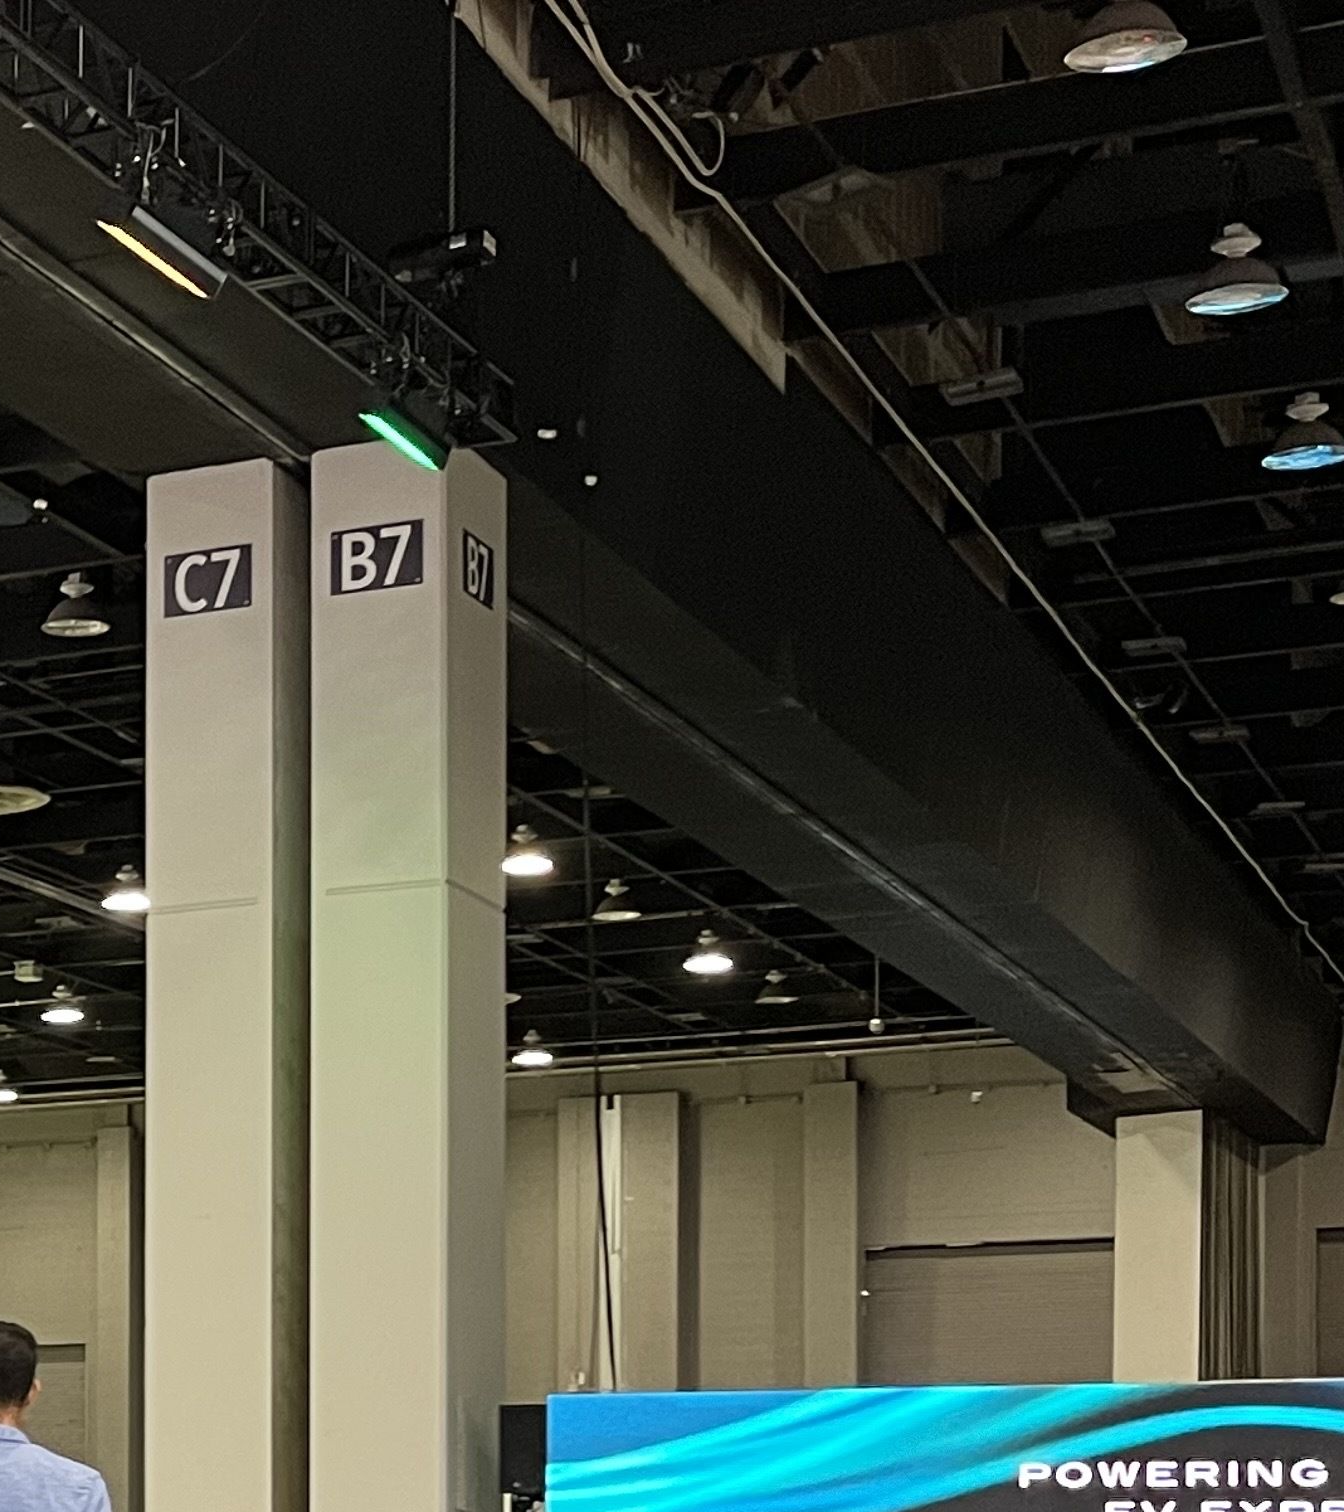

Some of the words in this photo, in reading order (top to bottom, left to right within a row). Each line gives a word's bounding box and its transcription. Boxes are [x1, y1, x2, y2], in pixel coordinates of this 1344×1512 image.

[174, 548, 242, 613] C7
[341, 524, 412, 592] B7
[467, 535, 490, 602] B7
[1018, 1459, 1329, 1489] POWERING
